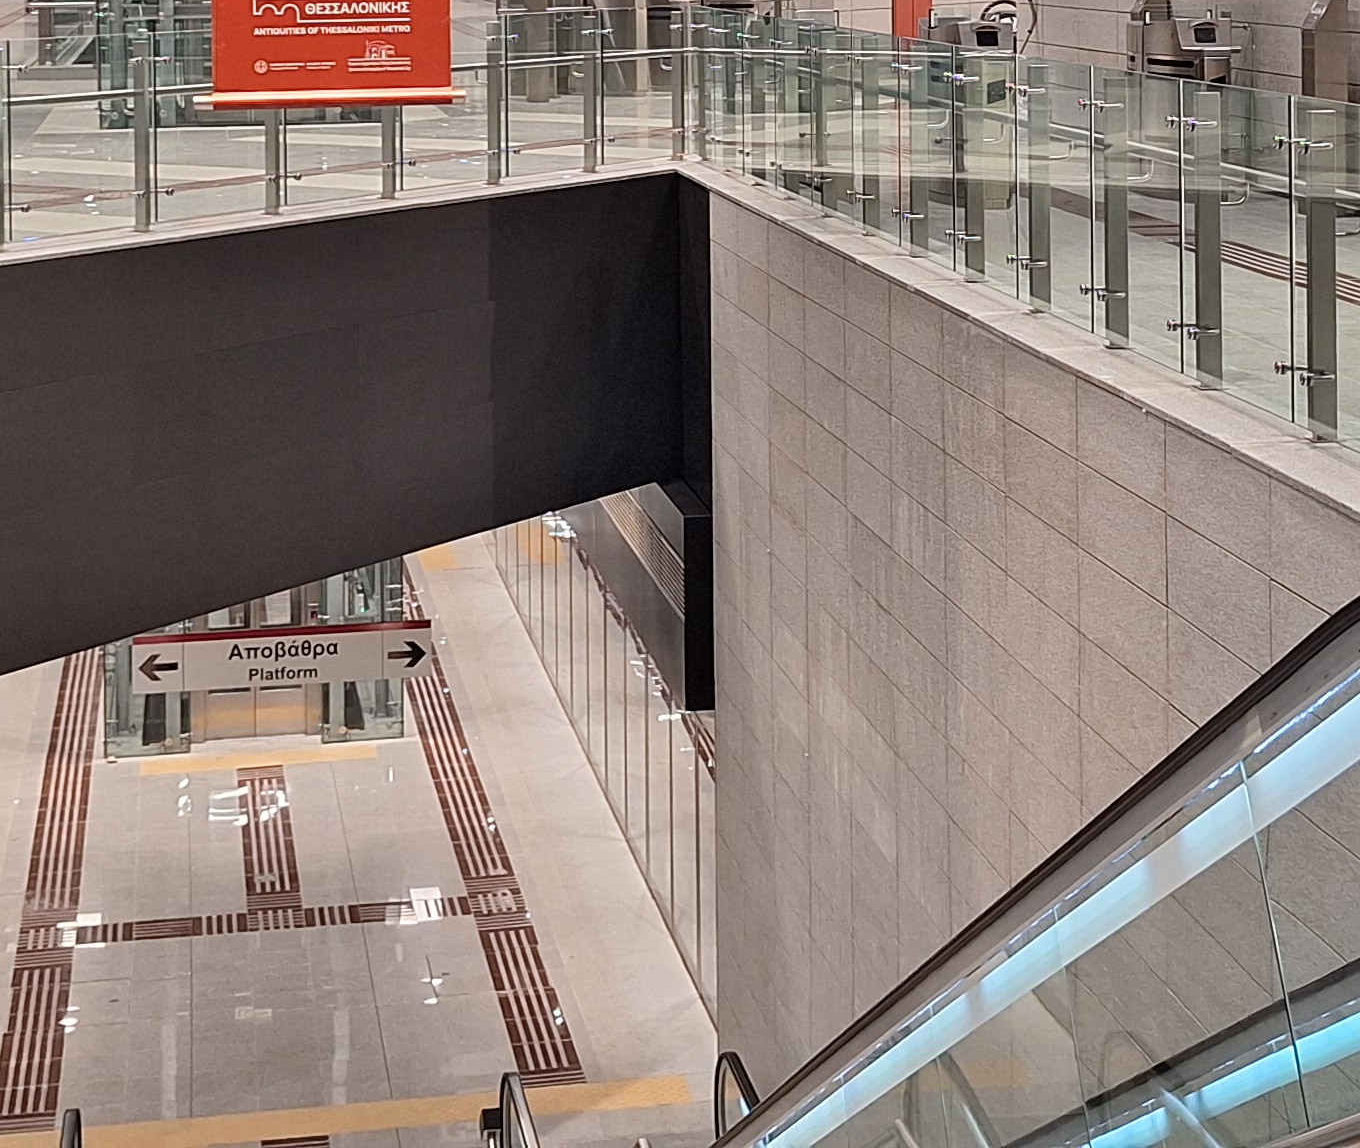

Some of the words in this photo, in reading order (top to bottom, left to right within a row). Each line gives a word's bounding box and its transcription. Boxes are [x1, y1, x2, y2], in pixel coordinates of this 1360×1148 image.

[305, 1, 410, 15] ΘΕΣΣΑΛΟΝΙΚΗΣ
[253, 26, 306, 35] ANTIQUITIES
[307, 26, 319, 35] OF
[320, 25, 380, 34] THESSALONIKI
[381, 25, 411, 33] METRO
[228, 640, 339, 662] Αποβάθρα
[248, 666, 318, 681] Platform
